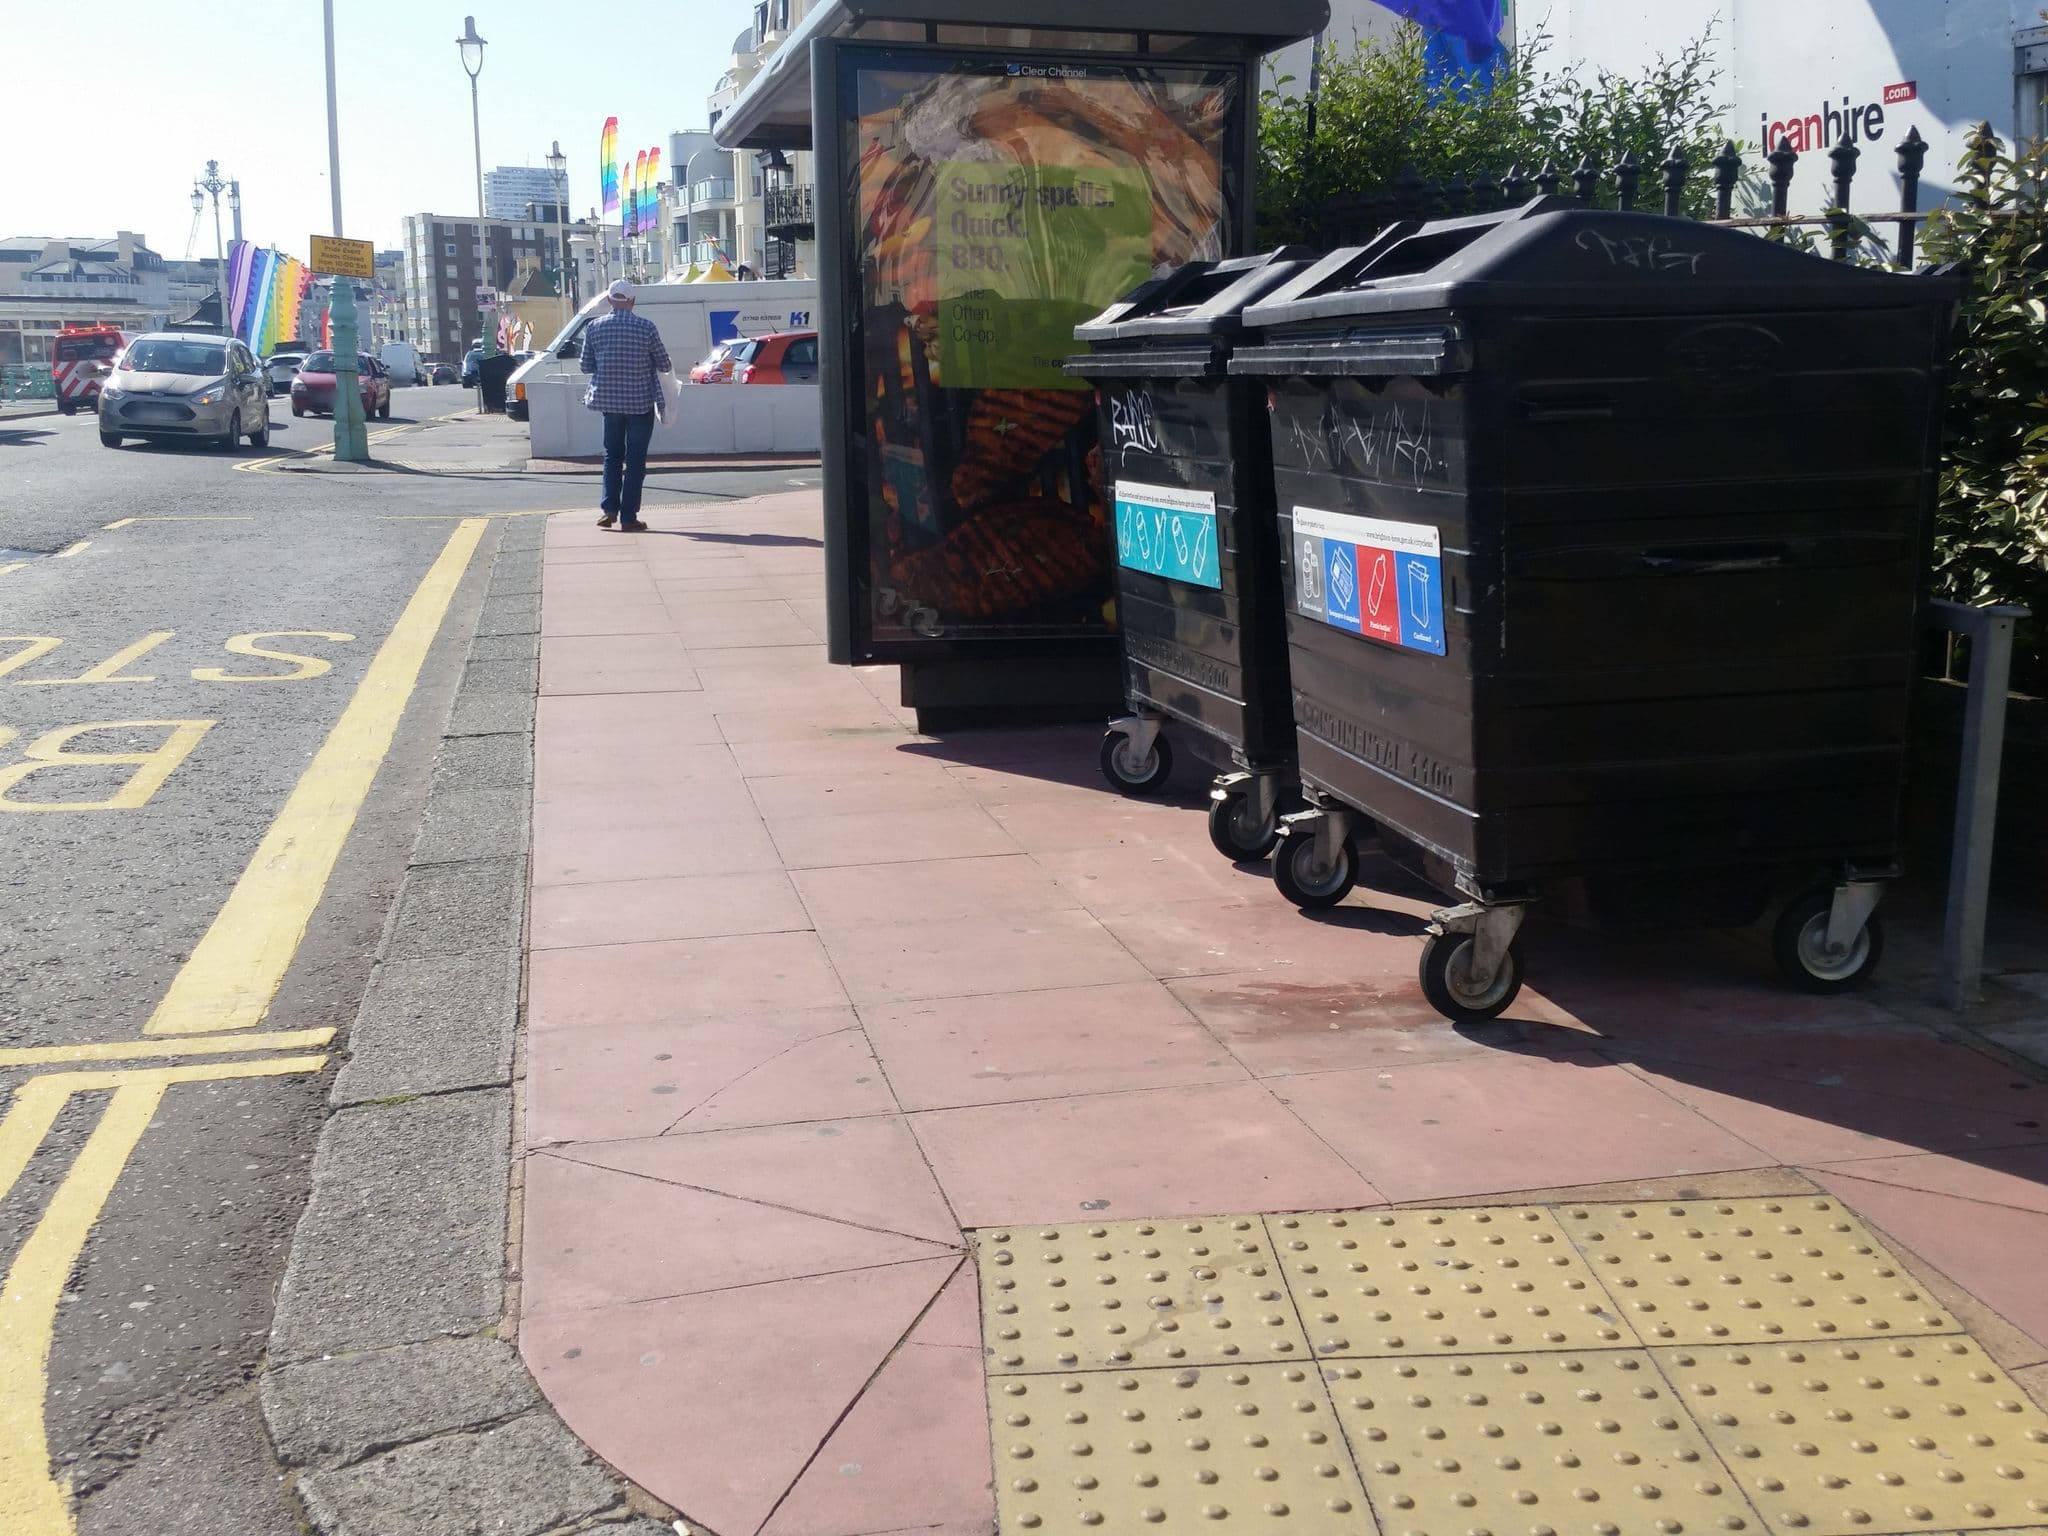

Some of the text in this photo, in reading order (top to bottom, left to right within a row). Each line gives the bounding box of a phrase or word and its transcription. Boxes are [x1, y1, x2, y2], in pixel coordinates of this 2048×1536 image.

[1021, 65, 1087, 78] Clear Channel
[1762, 85, 1910, 158] icanhire .com
[951, 176, 1115, 211] Sunny spells.
[951, 209, 1029, 239] Quick.
[952, 244, 1010, 272] BBQ.
[789, 311, 810, 325] K1
[952, 303, 993, 321] Often.
[952, 325, 999, 344] Co-op.
[1031, 356, 1049, 368] The
[0, 719, 217, 812] B
[1411, 751, 1454, 797] 1100
